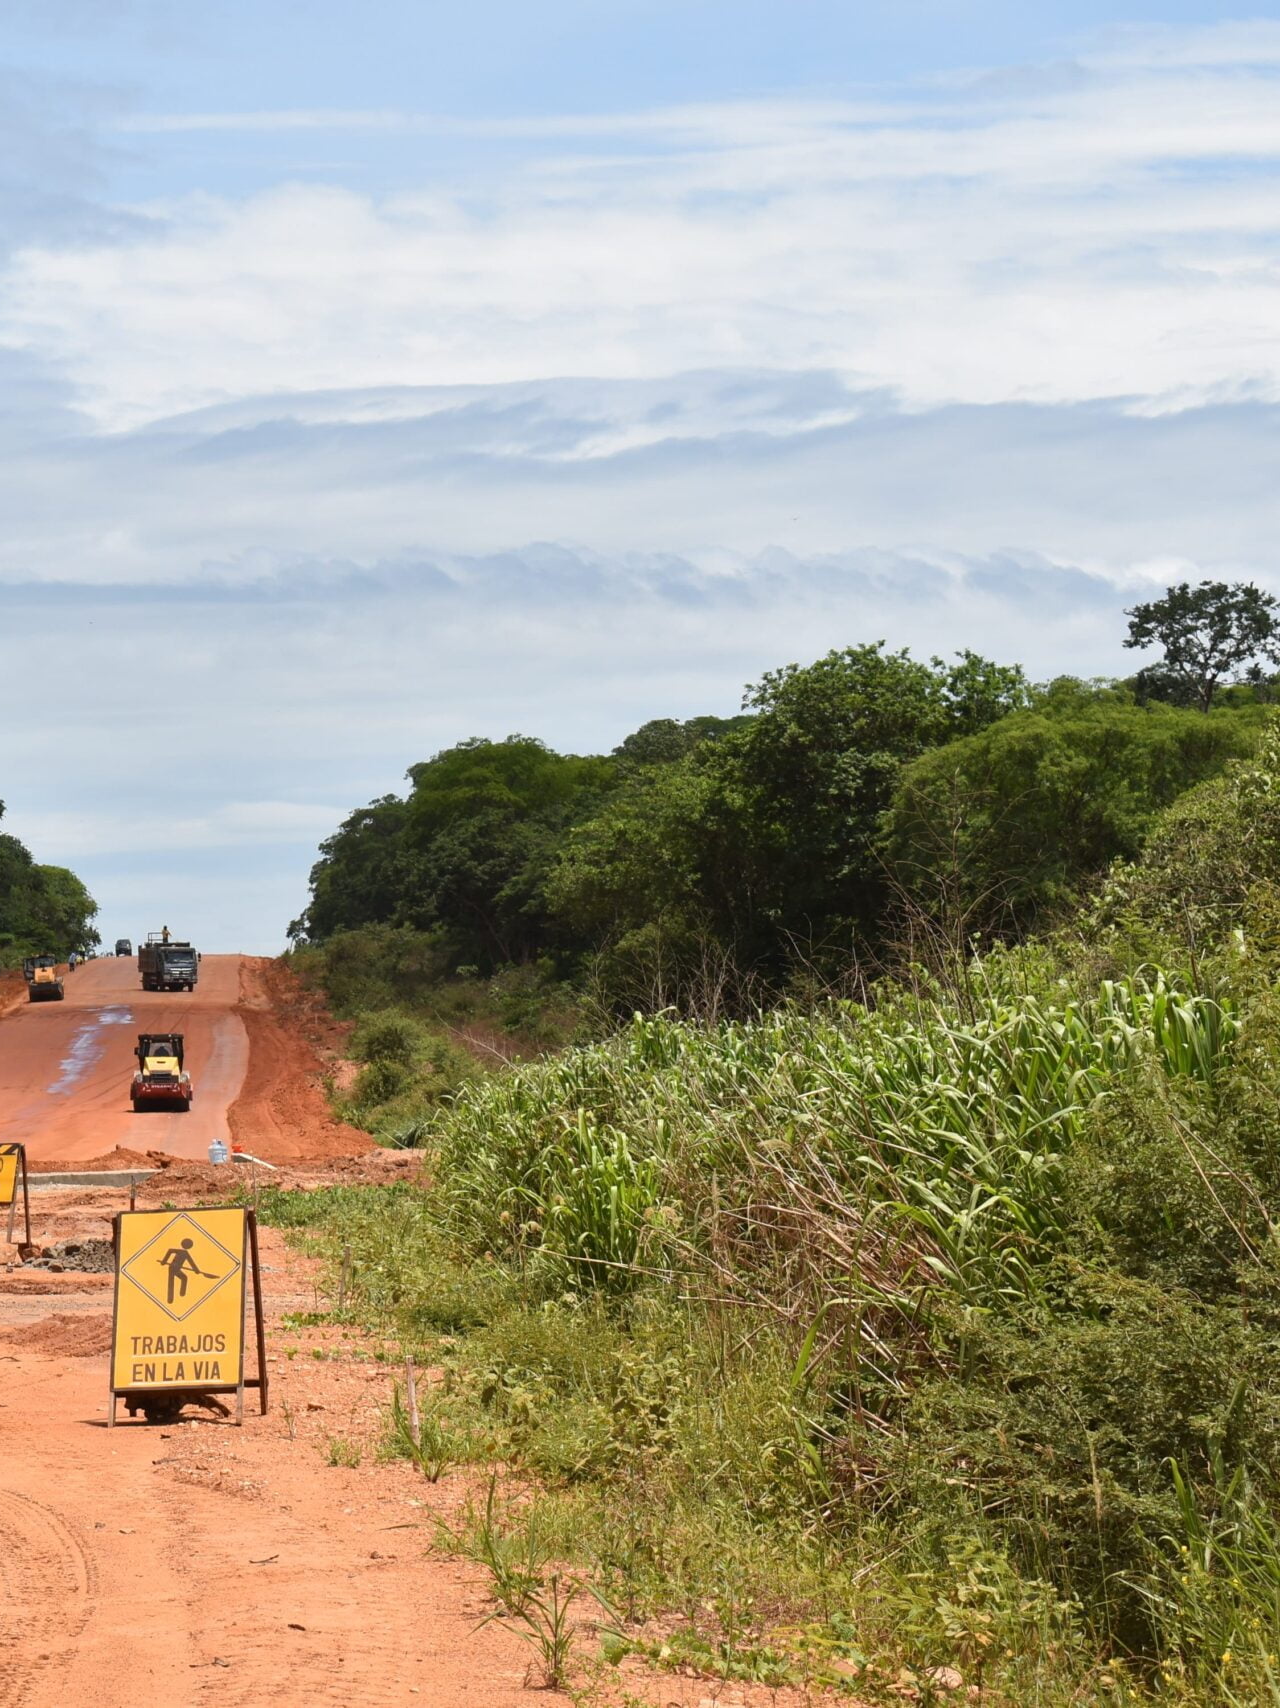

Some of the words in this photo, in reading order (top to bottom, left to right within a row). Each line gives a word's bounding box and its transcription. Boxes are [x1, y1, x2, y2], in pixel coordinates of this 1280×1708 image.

[130, 1333, 226, 1355] TRABAJOS
[132, 1363, 156, 1382] EN
[162, 1362, 185, 1381] LA
[193, 1361, 221, 1380] VIA
